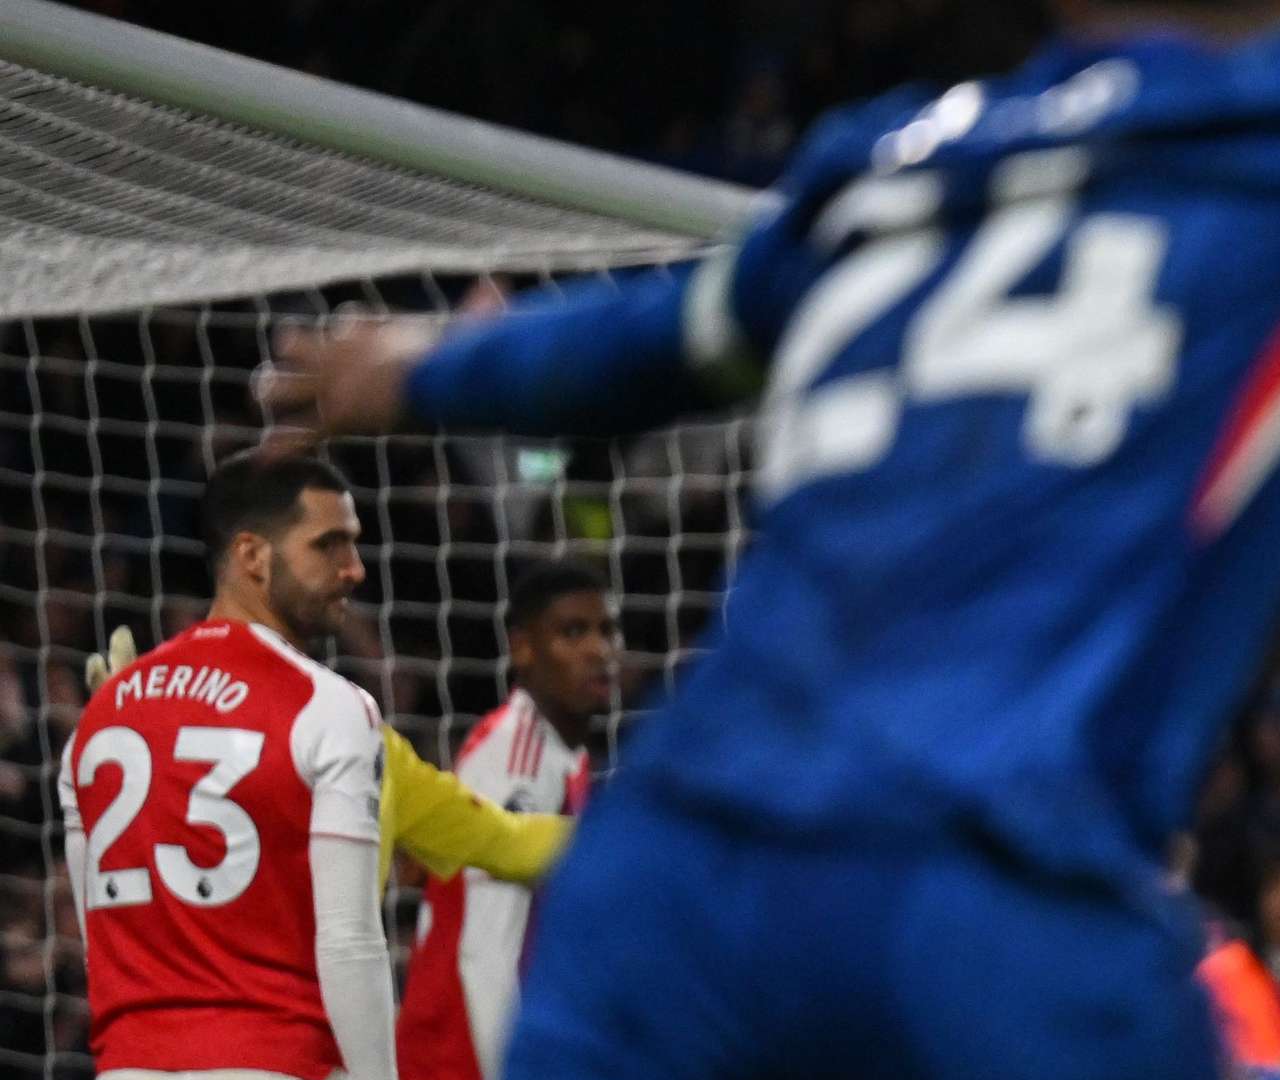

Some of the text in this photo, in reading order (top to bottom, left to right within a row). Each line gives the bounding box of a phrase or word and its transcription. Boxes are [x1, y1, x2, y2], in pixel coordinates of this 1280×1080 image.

[756, 150, 1182, 508] 24
[115, 664, 249, 712] MERINO
[78, 725, 266, 912] 23
